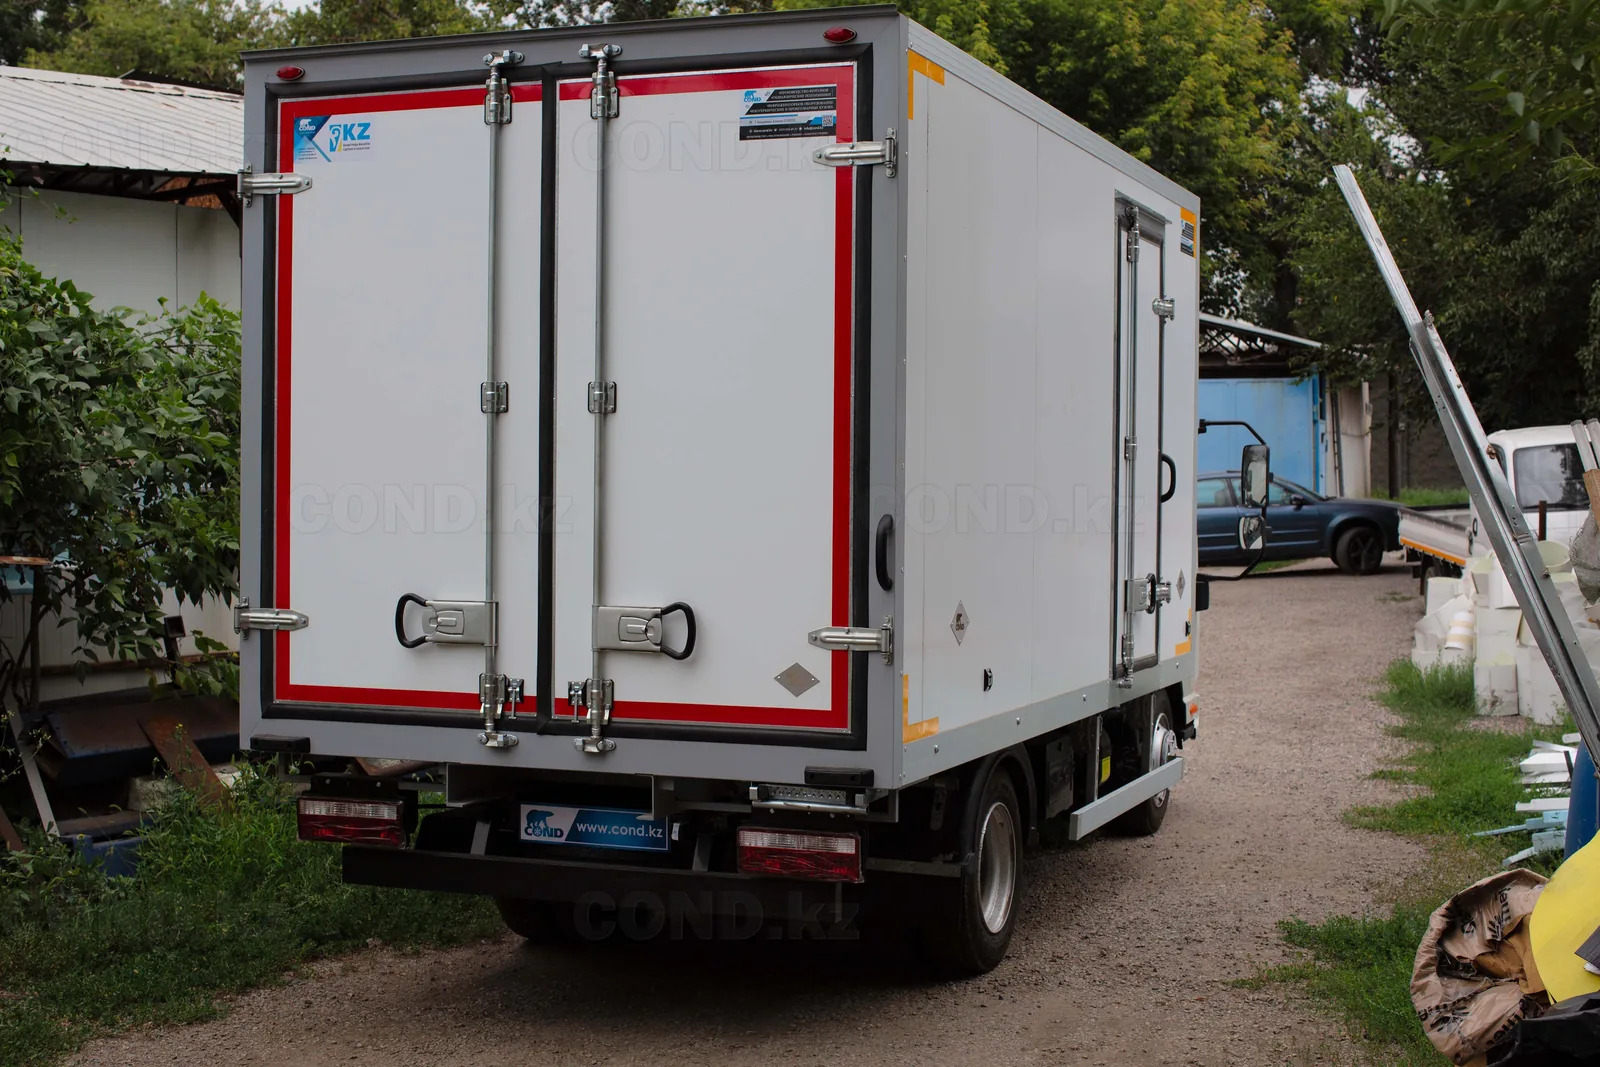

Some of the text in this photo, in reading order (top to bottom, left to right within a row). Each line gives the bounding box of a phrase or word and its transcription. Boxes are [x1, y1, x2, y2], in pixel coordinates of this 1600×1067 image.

[343, 122, 371, 141] KZ
[524, 827, 564, 839] COND
[576, 821, 664, 839] www.cond.kz
